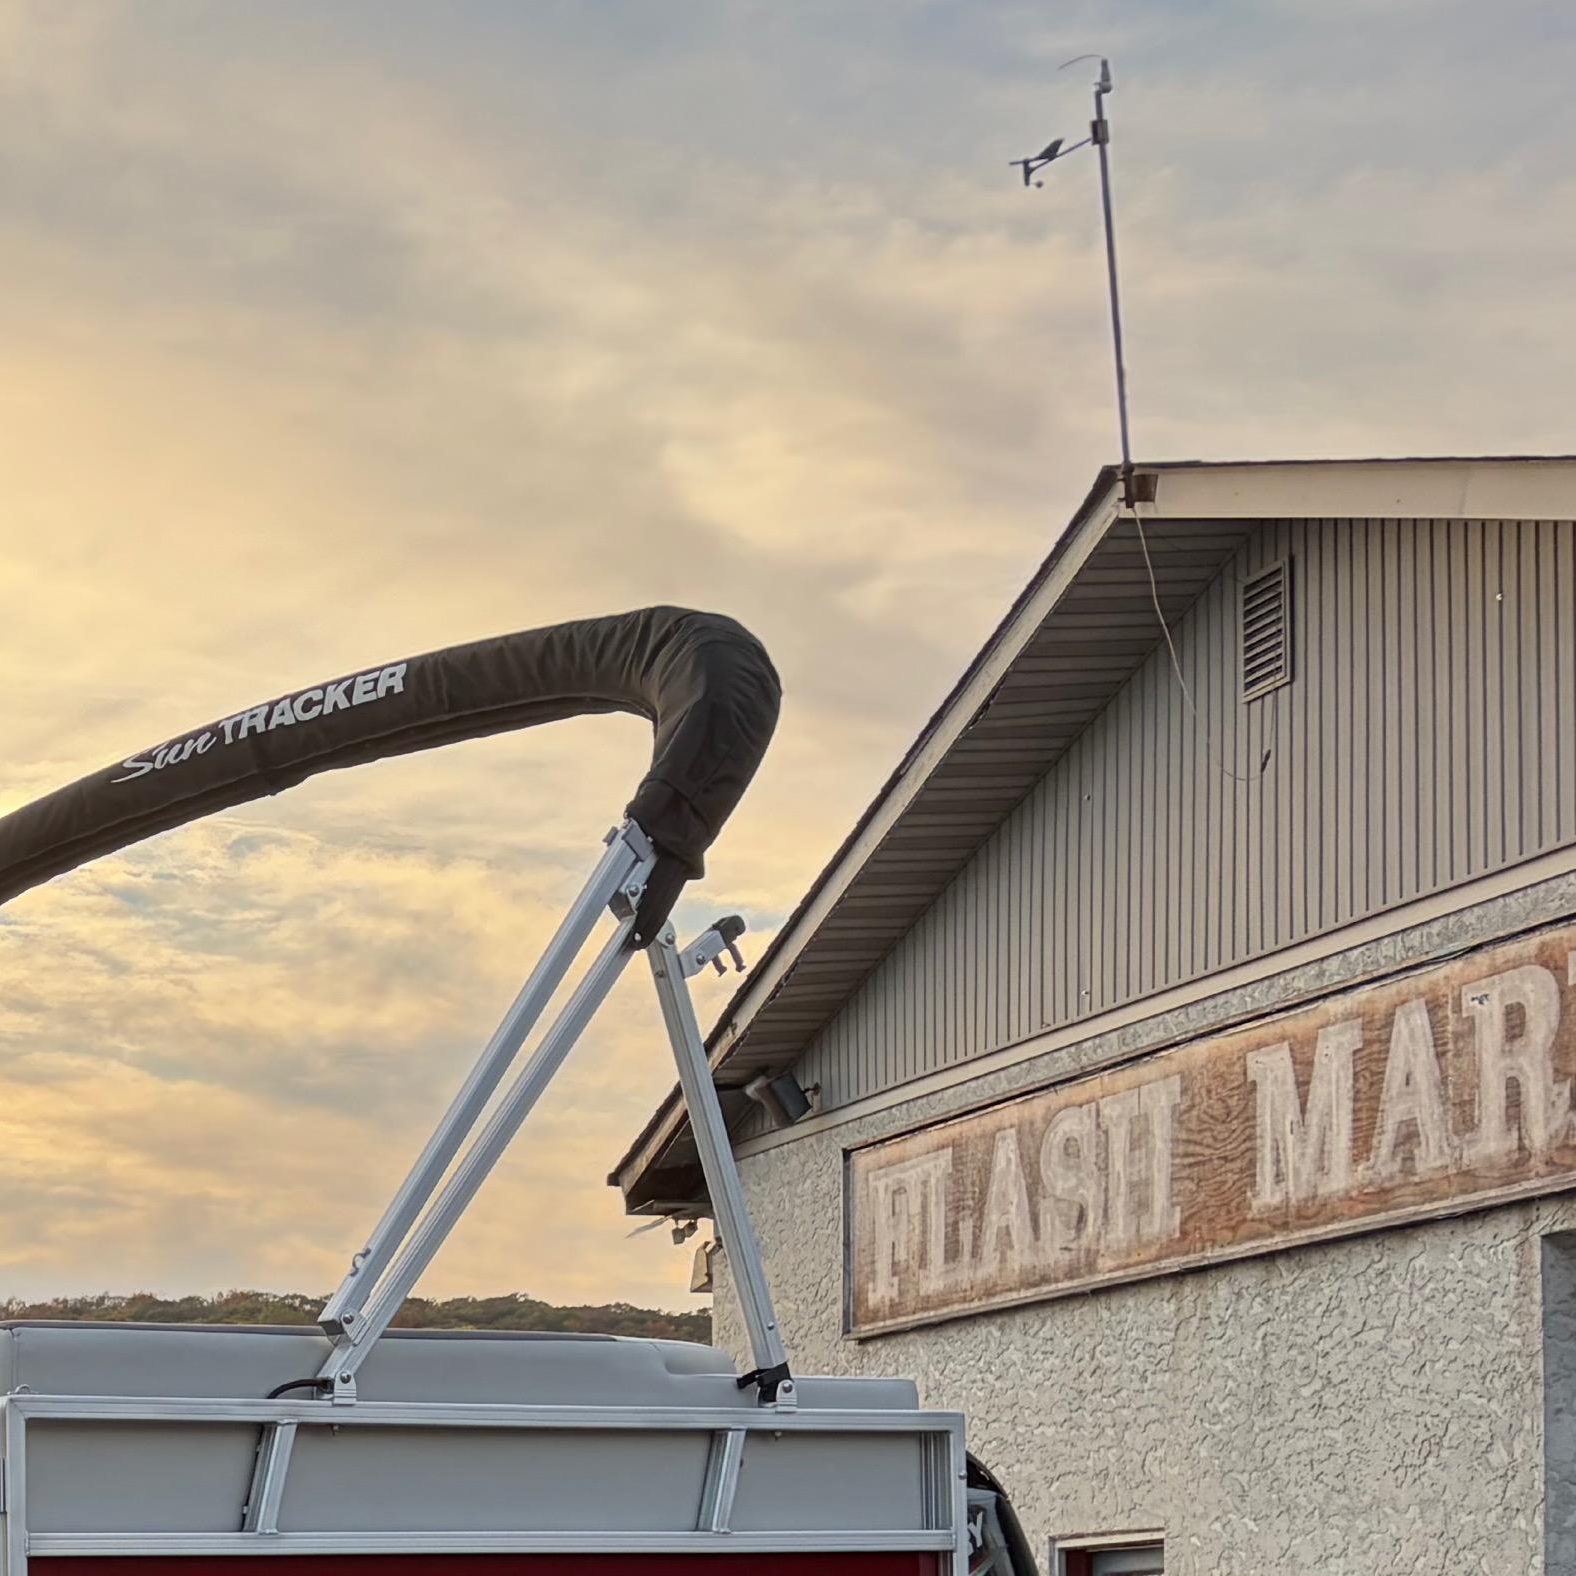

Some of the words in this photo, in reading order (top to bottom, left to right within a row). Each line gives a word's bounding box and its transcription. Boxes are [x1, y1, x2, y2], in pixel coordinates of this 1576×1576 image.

[110, 731, 218, 784] Sun
[218, 662, 408, 745] TRACKER
[1245, 948, 1576, 1221] MAR
